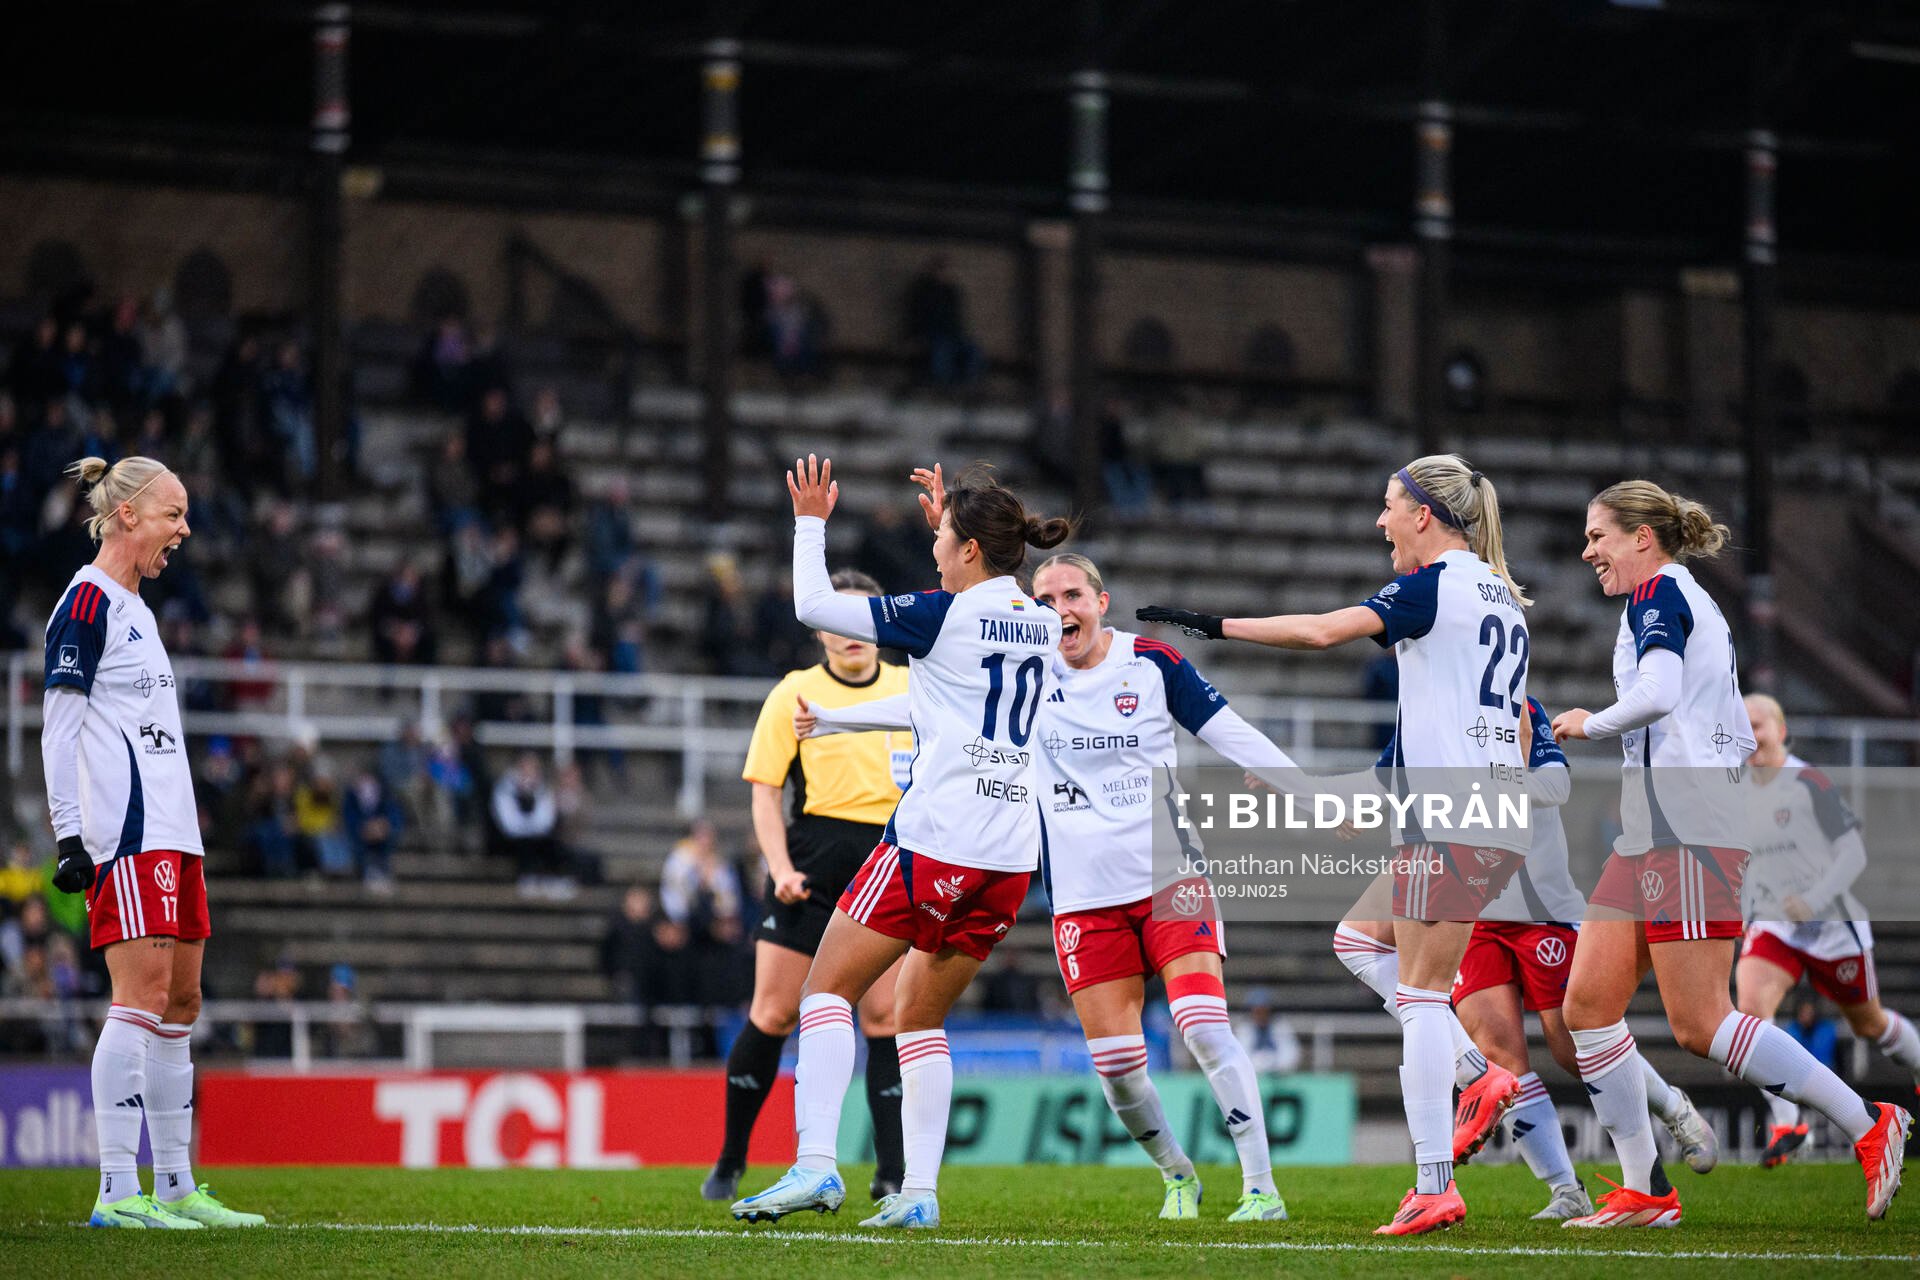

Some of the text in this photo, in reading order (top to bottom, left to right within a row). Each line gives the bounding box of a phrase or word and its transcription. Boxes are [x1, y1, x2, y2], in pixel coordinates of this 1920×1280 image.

[980, 618, 1049, 646] TANIKAWA
[1479, 614, 1529, 719] 22
[981, 652, 1043, 747] 10
[1116, 696, 1137, 707] FCR
[1102, 775, 1150, 795] MELLBY
[1489, 761, 1524, 785] NEXE
[976, 777, 1029, 804] NEXER
[1111, 791, 1147, 808] GÅRD
[161, 895, 177, 922] 17
[1067, 954, 1080, 981] 6
[372, 1075, 641, 1170] TCL
